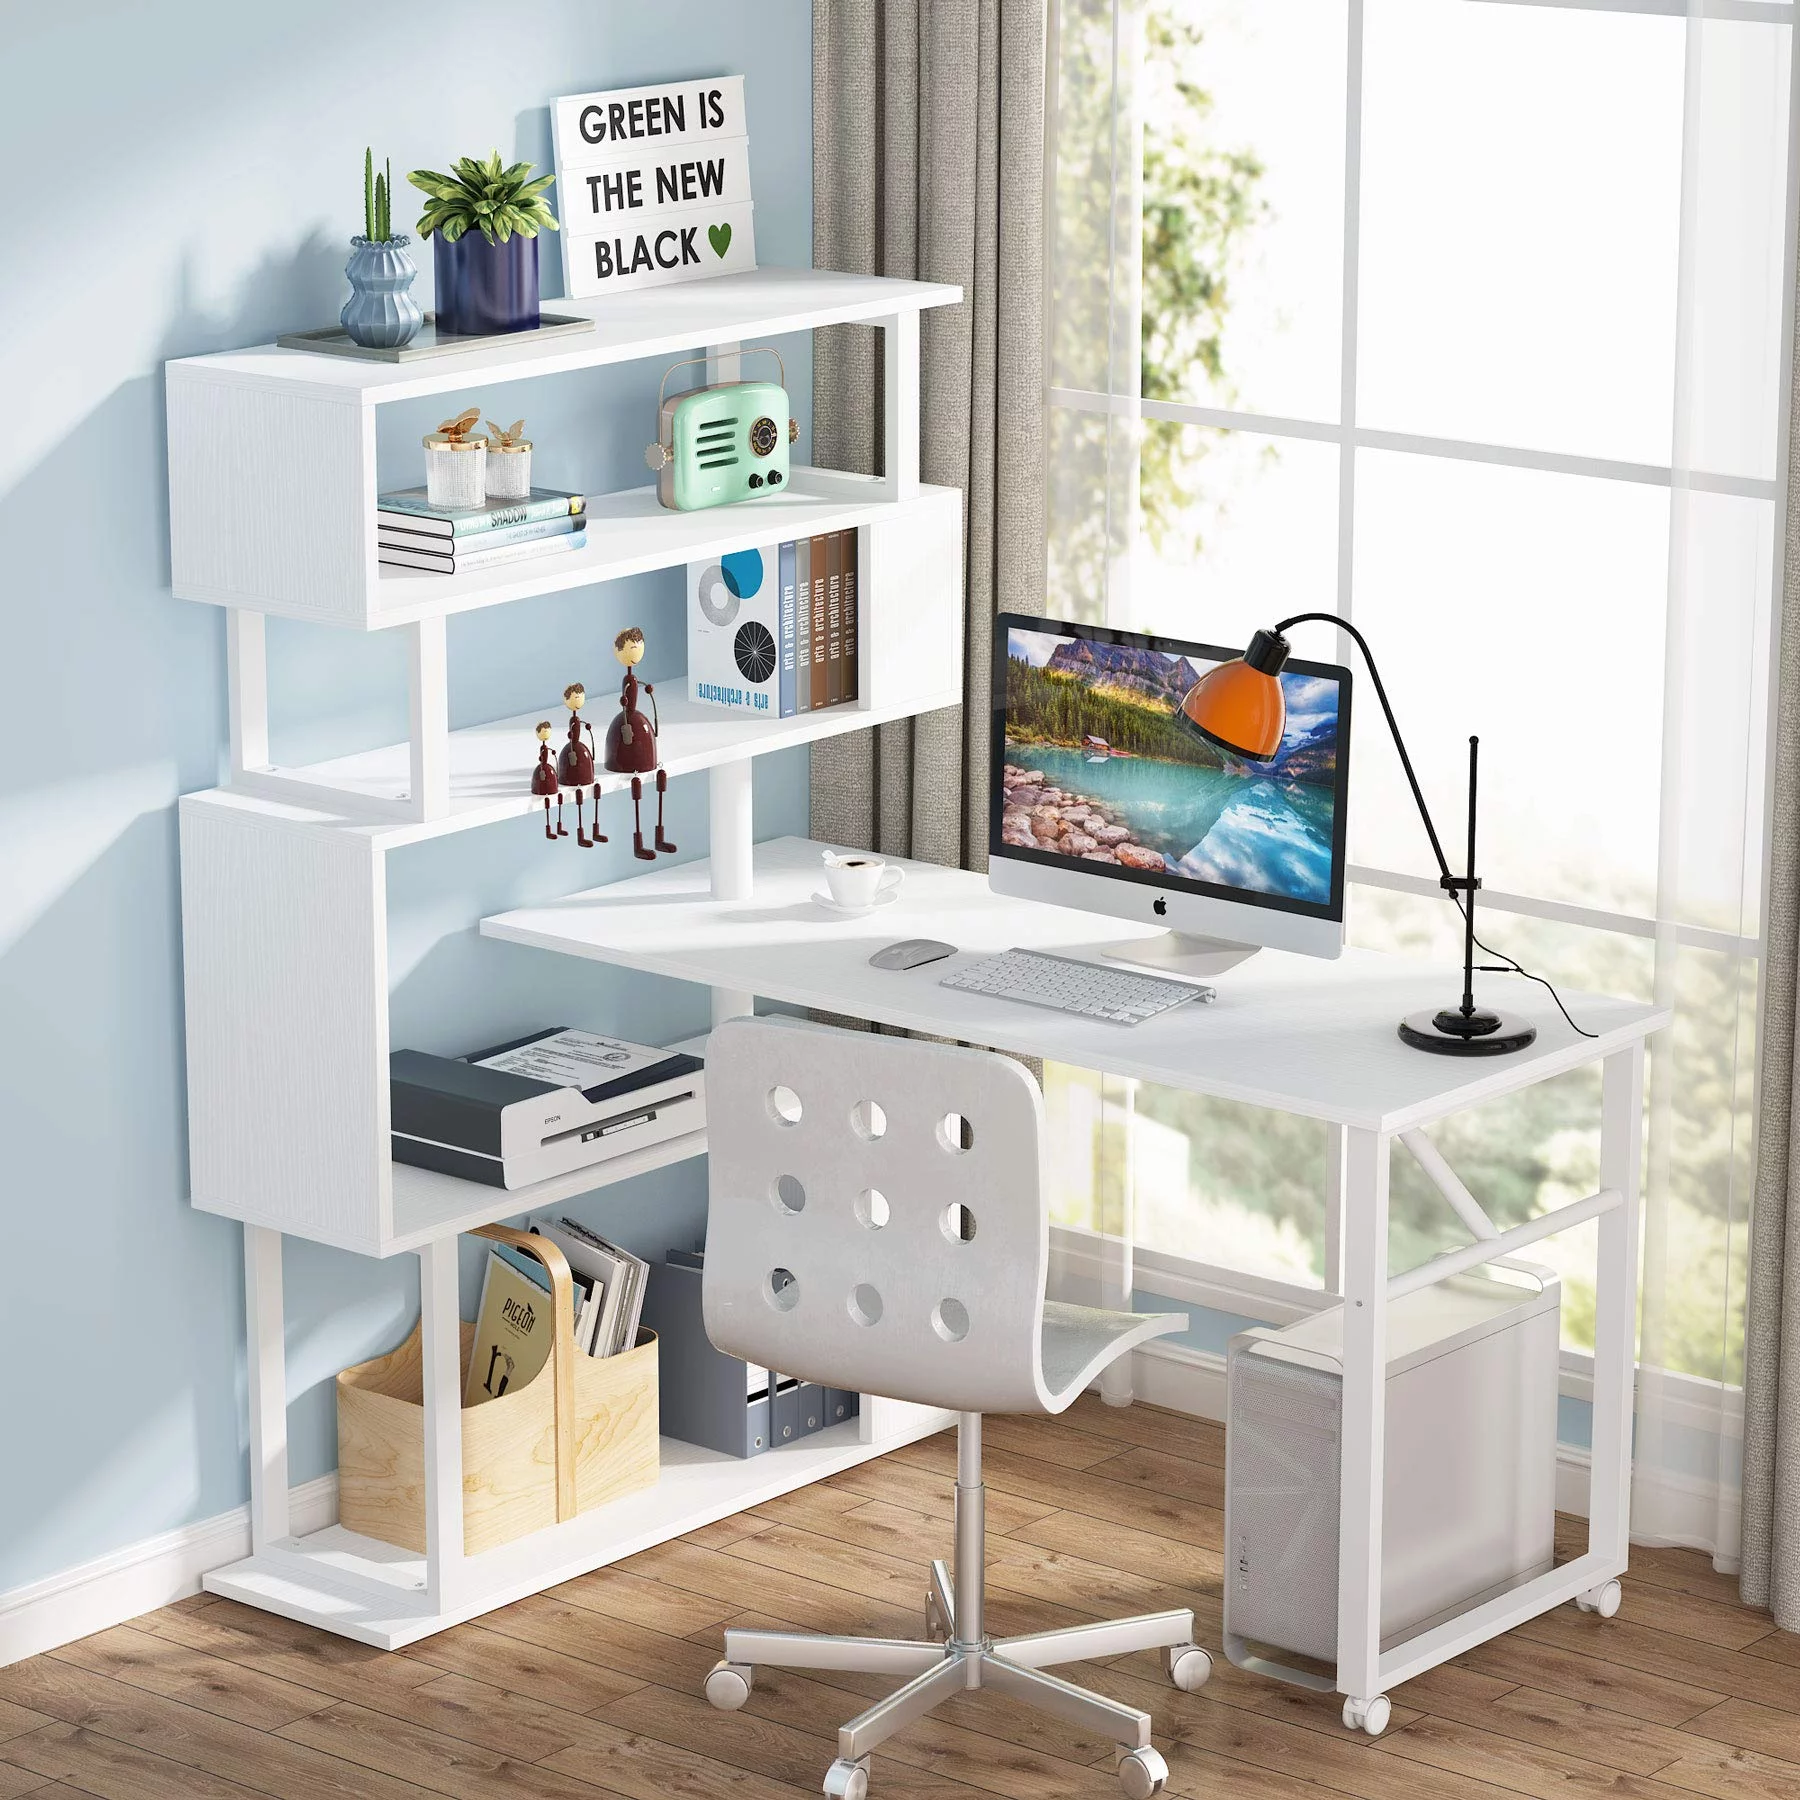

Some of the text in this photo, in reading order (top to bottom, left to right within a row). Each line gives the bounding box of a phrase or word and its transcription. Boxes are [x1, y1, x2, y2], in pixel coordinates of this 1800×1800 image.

[579, 90, 724, 144] GREEN IS
[586, 158, 725, 213] THE NEW
[595, 227, 701, 279] BLACK
[491, 505, 527, 528] SHADOW
[783, 585, 794, 639] architecture
[798, 582, 809, 635] architecture
[813, 578, 824, 632] architecture
[828, 575, 839, 628] architecture
[784, 652, 794, 670] arts
[799, 648, 809, 666] arts
[814, 645, 824, 663] arts
[829, 641, 839, 659] arts
[699, 683, 742, 706] architecture
[754, 692, 768, 710] arts
[544, 1115, 560, 1124] EPSON
[502, 1298, 536, 1332] PIGEON
